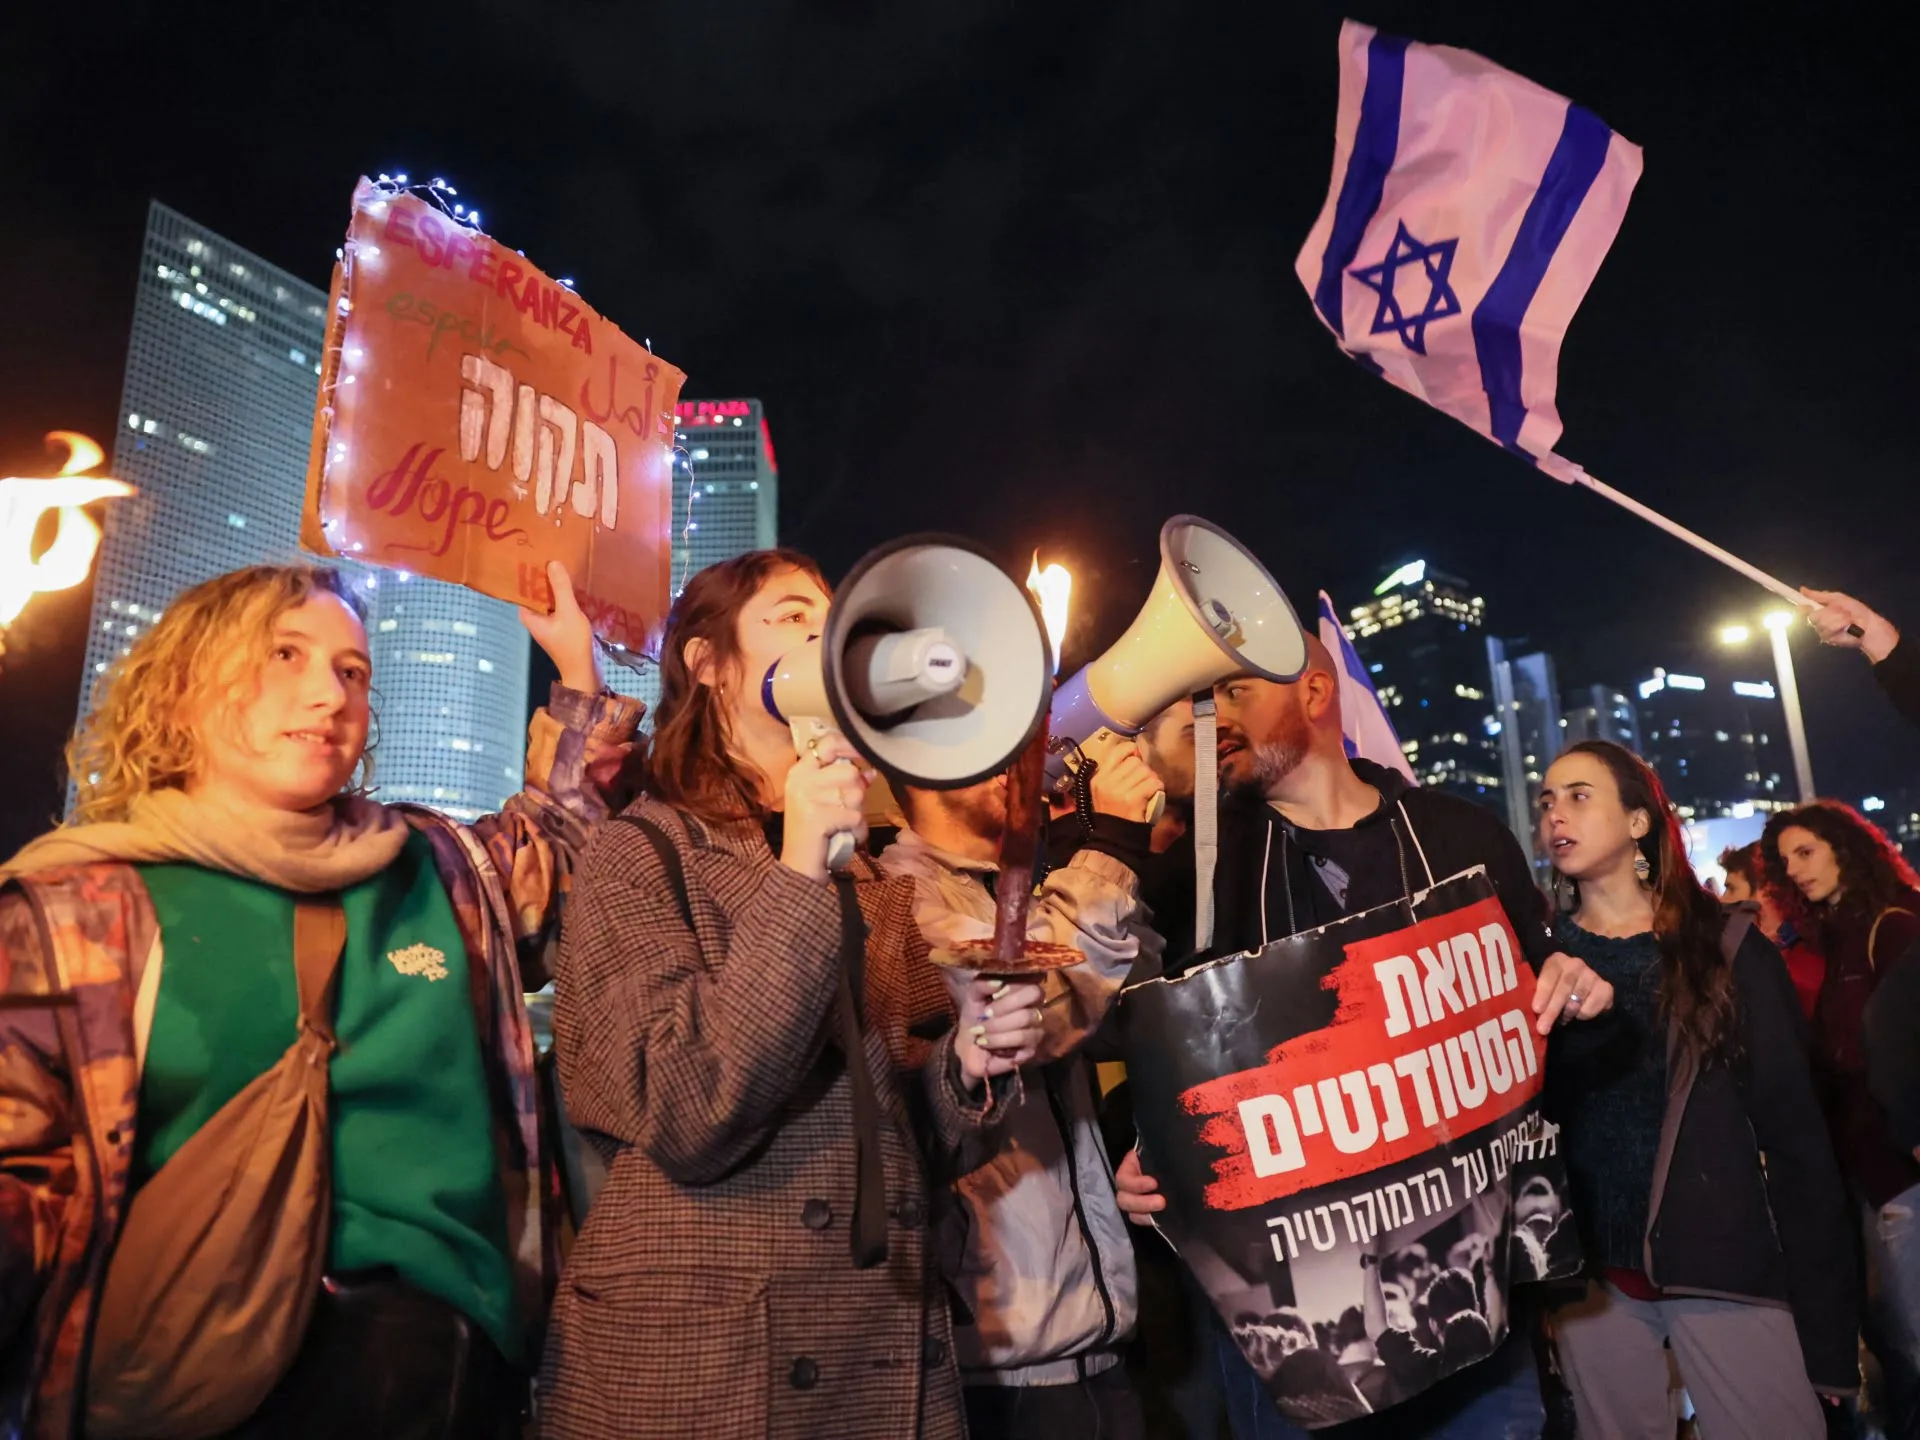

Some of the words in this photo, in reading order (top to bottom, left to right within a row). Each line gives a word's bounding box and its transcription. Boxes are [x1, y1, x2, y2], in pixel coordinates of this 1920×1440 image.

[384, 206, 592, 356] ESPERANZA
[366, 441, 533, 556] Hope
[1374, 921, 1519, 1039] מחאת
[1237, 1009, 1537, 1179] הסטודנטים
[1267, 1166, 1453, 1263] הדמוקרטיה
[1453, 1154, 1489, 1200] על
